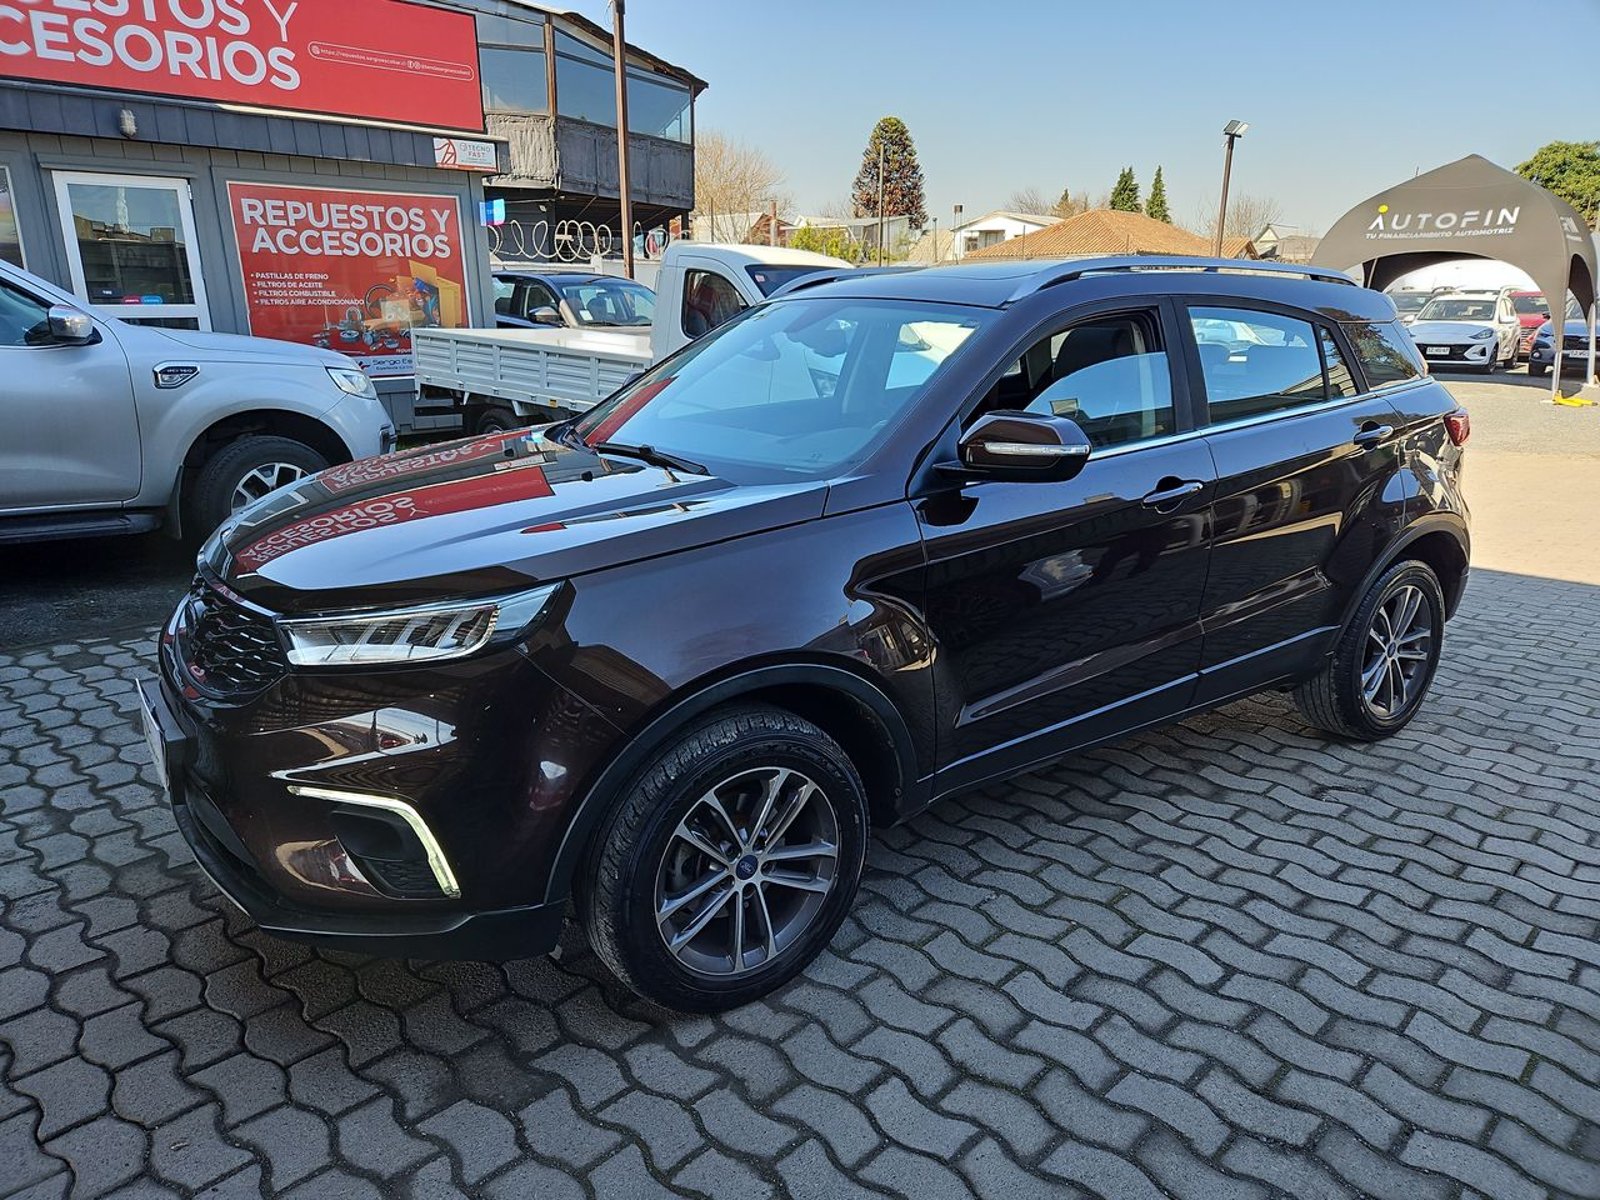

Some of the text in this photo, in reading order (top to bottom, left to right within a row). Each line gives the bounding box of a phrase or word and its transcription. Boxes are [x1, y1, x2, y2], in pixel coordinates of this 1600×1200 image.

[262, 0, 299, 42] Y
[240, 198, 450, 233] REPUESTOS Y
[1368, 205, 1521, 230] AUTOFIN
[252, 227, 450, 258] ACCESORIOS
[1378, 231, 1452, 240] FINANCIAMIENTO
[1455, 227, 1515, 238] AUTOMOTRIZ
[255, 272, 293, 280] PASTILLAS
